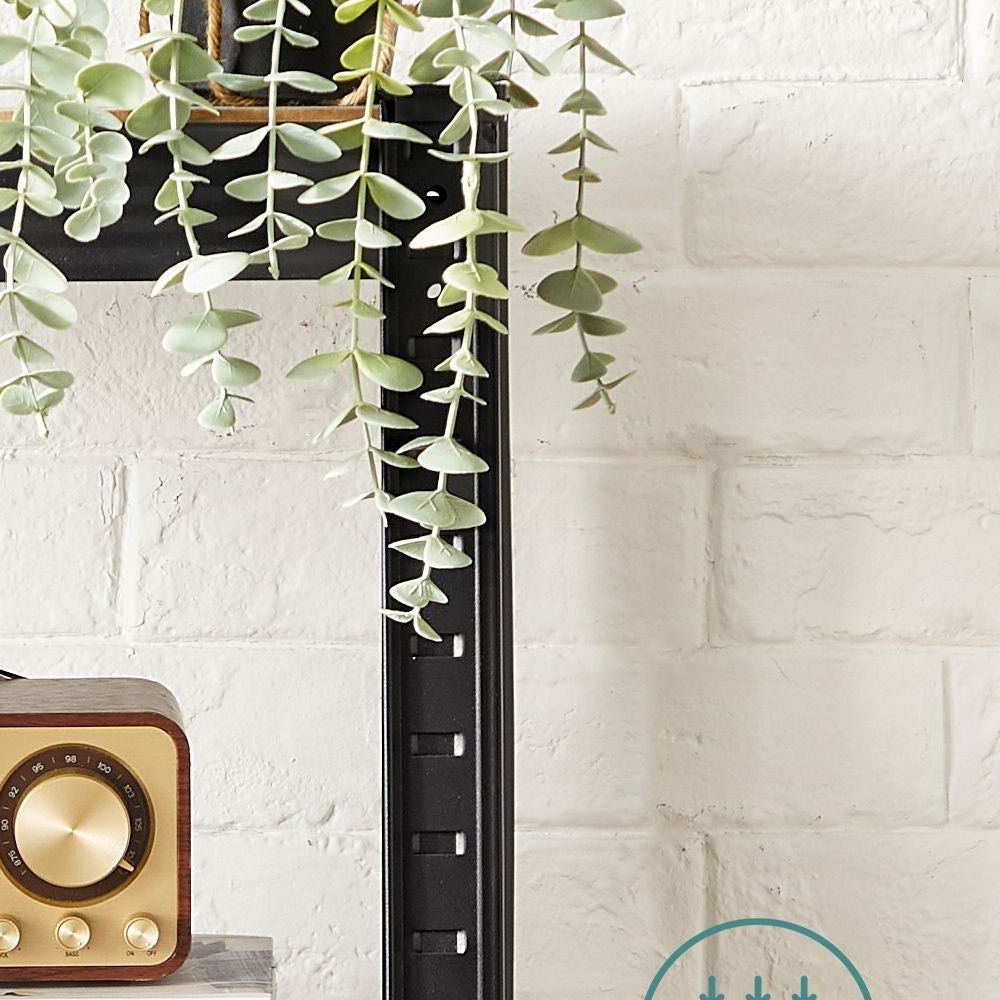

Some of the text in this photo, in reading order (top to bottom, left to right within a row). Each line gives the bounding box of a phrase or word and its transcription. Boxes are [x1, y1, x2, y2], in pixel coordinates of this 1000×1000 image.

[64, 755, 77, 764] 98
[31, 762, 44, 774] 95
[97, 761, 112, 774] 100
[8, 786, 19, 798] 92
[1, 819, 9, 831] 90
